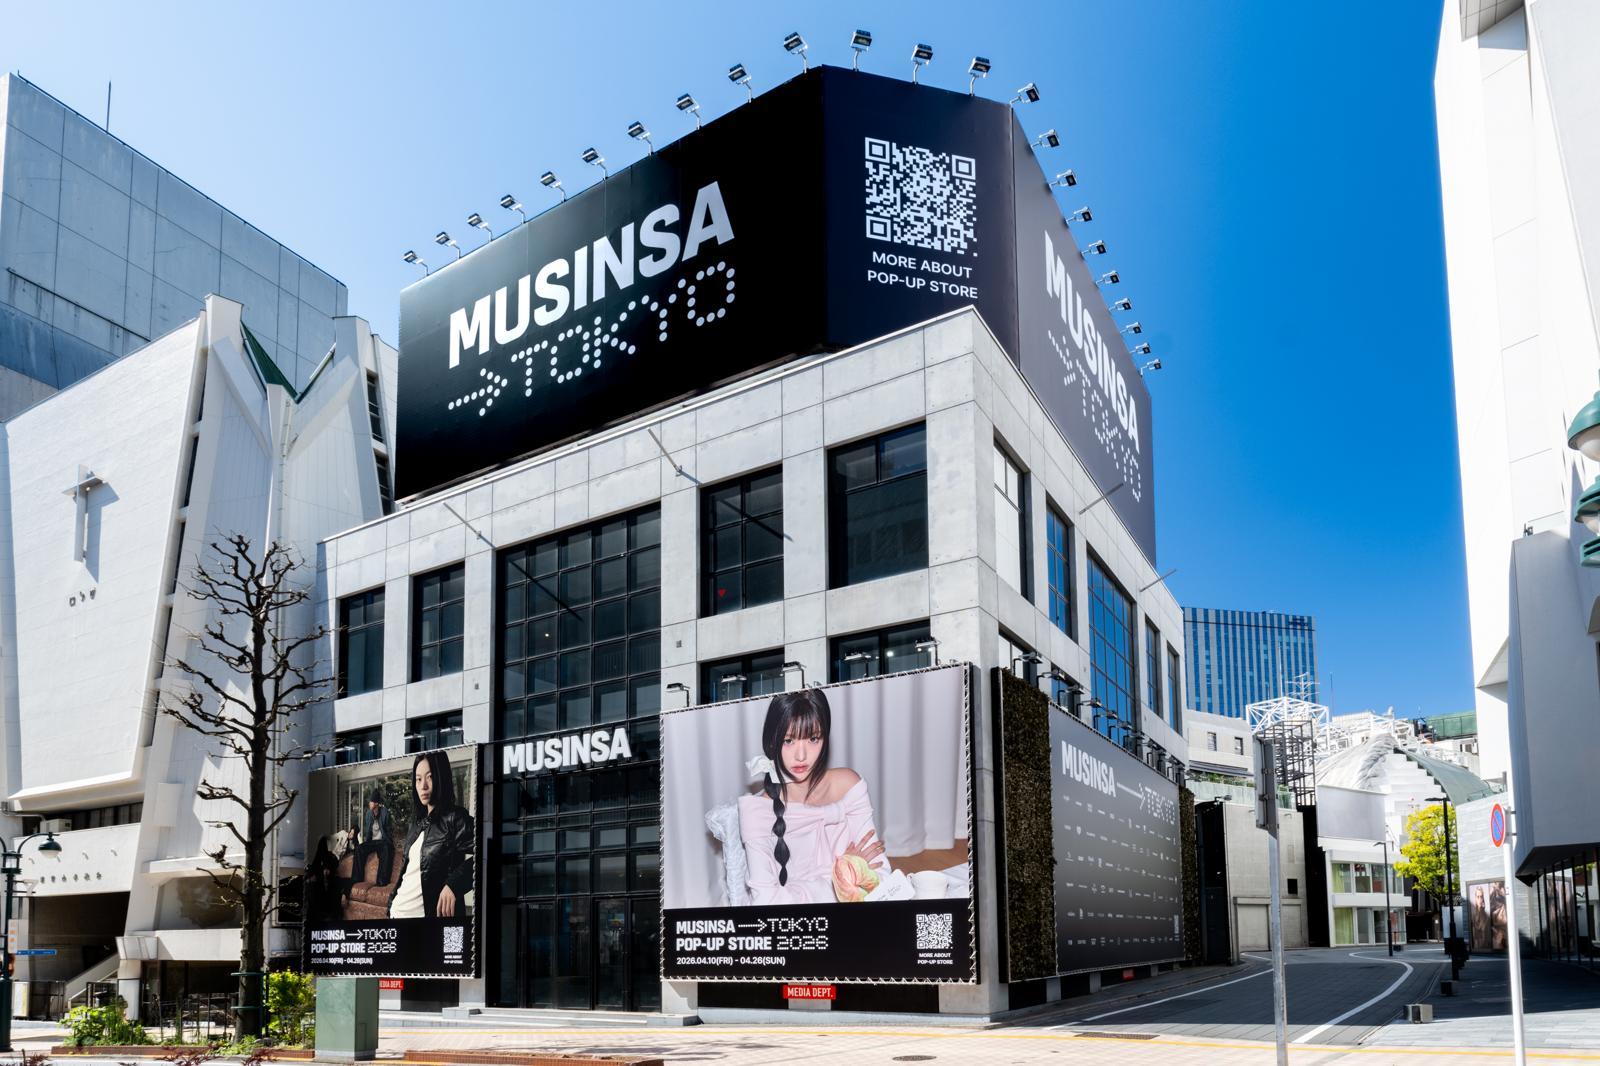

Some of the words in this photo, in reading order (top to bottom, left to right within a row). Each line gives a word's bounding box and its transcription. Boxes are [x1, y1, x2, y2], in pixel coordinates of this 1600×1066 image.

[449, 181, 735, 369] MUSINSA
[872, 251, 917, 270] MORE
[920, 260, 973, 279] ABOUT
[867, 269, 927, 290] POP-UP
[929, 280, 979, 299] STORE
[510, 260, 736, 398] TOKYO
[1044, 230, 1139, 454] MUSINSA
[1075, 359, 1141, 502] TOKYO
[503, 727, 632, 775] MUSINSA
[1061, 741, 1116, 797] MUSINSA
[311, 929, 346, 941] MUSINSA
[362, 928, 398, 940] TOKYO
[675, 919, 736, 934] MUSINSA
[767, 916, 829, 932] TOKYO
[311, 943, 338, 954] POP-UP
[340, 942, 366, 953] STORE
[367, 942, 398, 954] 2026
[675, 937, 725, 951] POP-UP
[728, 936, 773, 950] STORE
[776, 935, 829, 951] 2026
[676, 957, 733, 966] 2026.04.10(FRI)
[739, 956, 786, 966] 04.26(SUN)
[787, 986, 811, 997] MEDIA
[812, 987, 834, 998] DEPT.
